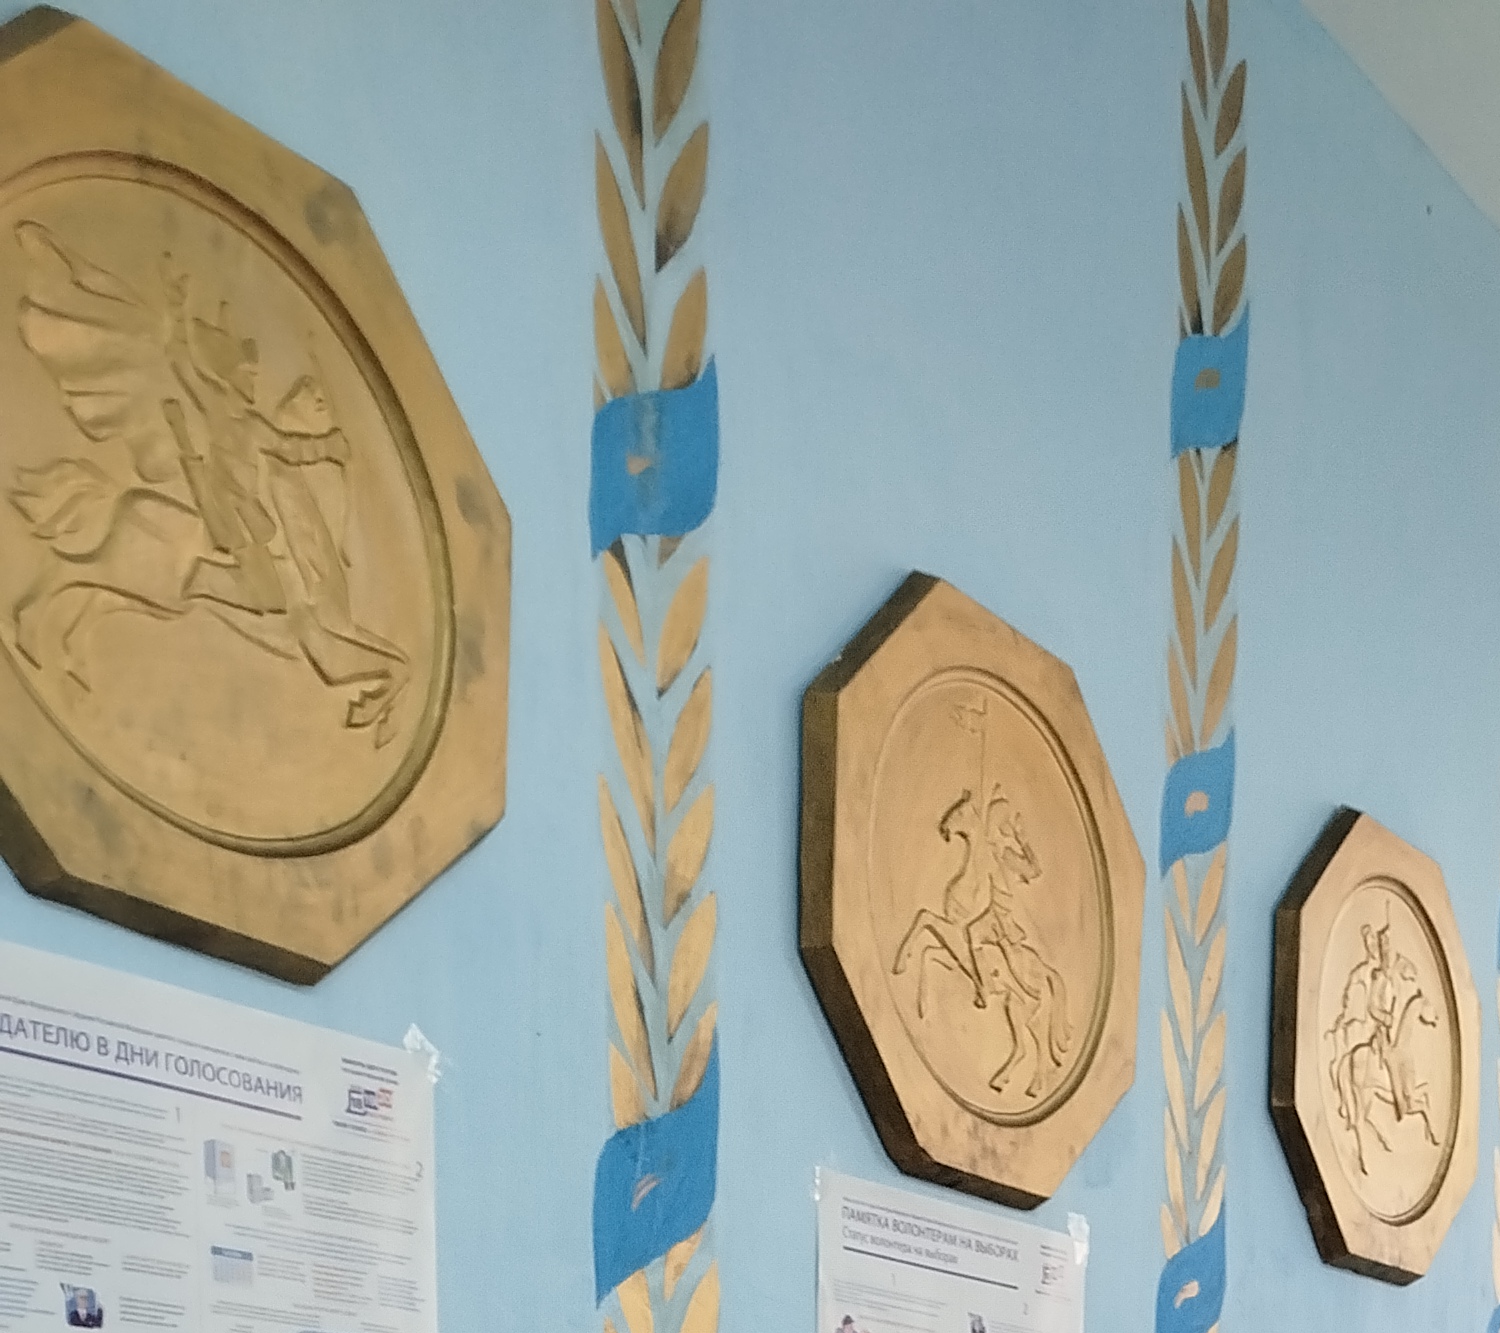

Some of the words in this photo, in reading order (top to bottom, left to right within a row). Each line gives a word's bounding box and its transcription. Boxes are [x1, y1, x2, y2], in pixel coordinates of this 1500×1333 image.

[96, 1035, 110, 1057] В
[115, 1040, 160, 1069] ДНИ
[165, 1052, 304, 1104] ГОЛОСОВАНИЯ
